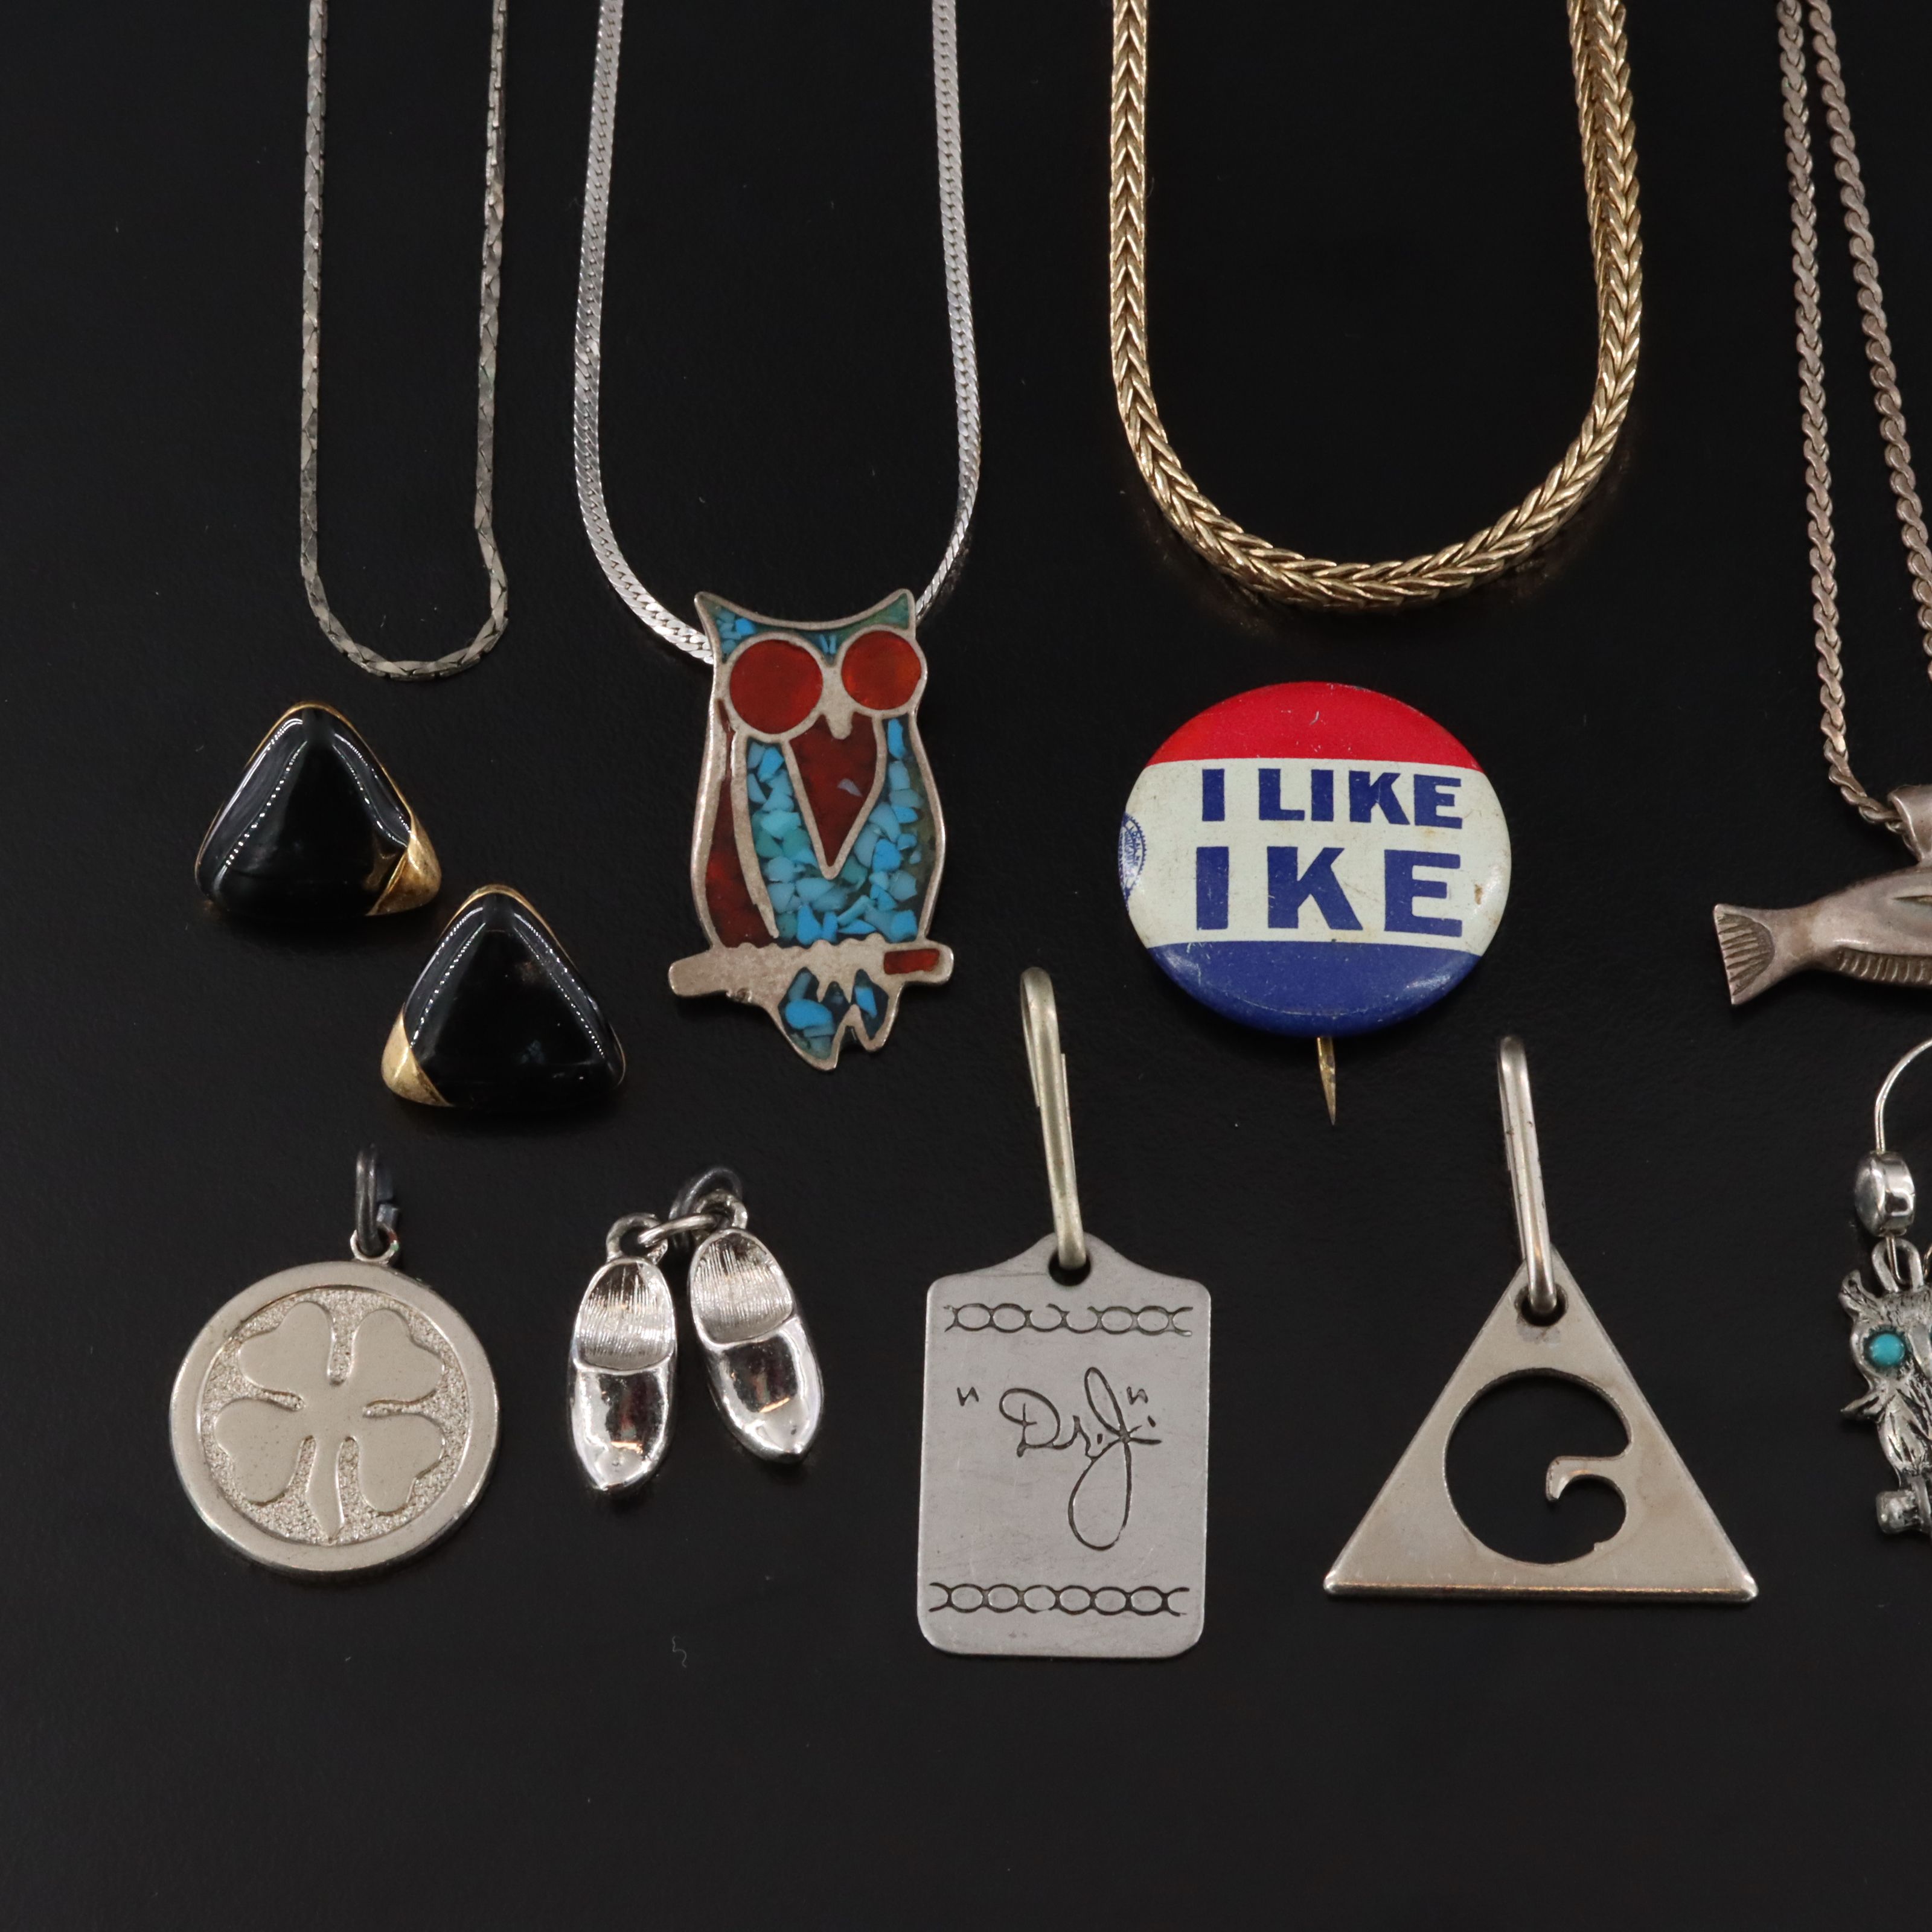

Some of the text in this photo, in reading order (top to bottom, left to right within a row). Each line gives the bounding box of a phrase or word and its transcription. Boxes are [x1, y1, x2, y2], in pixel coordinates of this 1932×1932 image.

[1201, 767, 1463, 830] I LIKE
[1195, 845, 1463, 938] IKE
